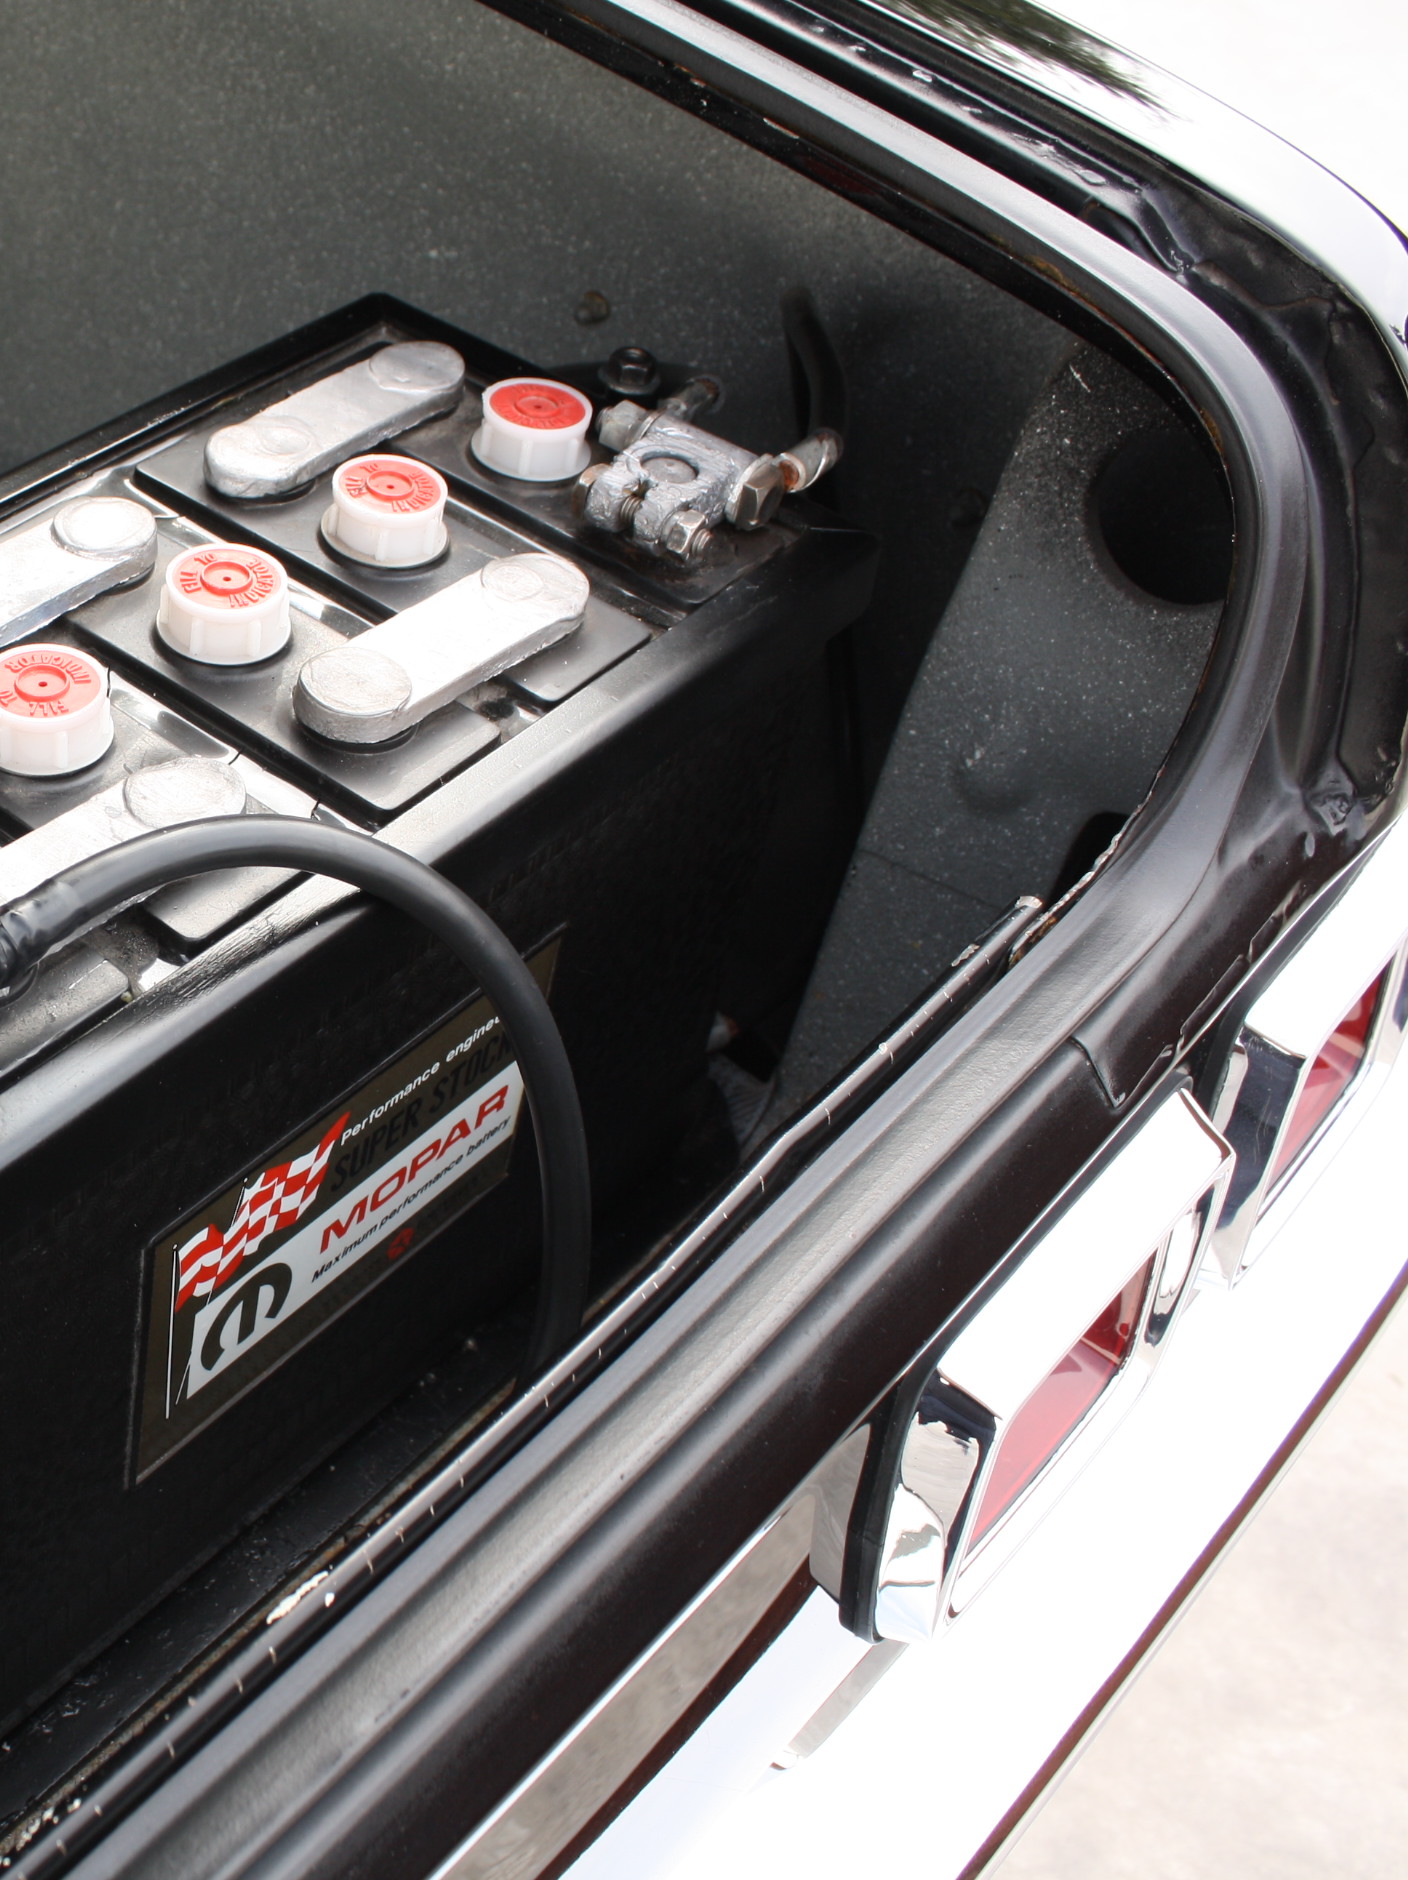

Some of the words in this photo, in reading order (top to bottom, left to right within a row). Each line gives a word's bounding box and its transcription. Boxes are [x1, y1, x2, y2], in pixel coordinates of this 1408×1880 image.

[180, 570, 202, 594] FILL
[194, 552, 218, 566] TO
[229, 558, 274, 608] INDICATOR
[4, 654, 92, 685] INDICATOR
[29, 701, 69, 717] FILL
[331, 1097, 423, 1192] SUPER
[340, 1062, 441, 1146] Performance
[311, 1222, 379, 1284] Maximum
[379, 1154, 464, 1230] performance
[466, 1116, 511, 1157] battery
[320, 1085, 508, 1254] MOPAR
